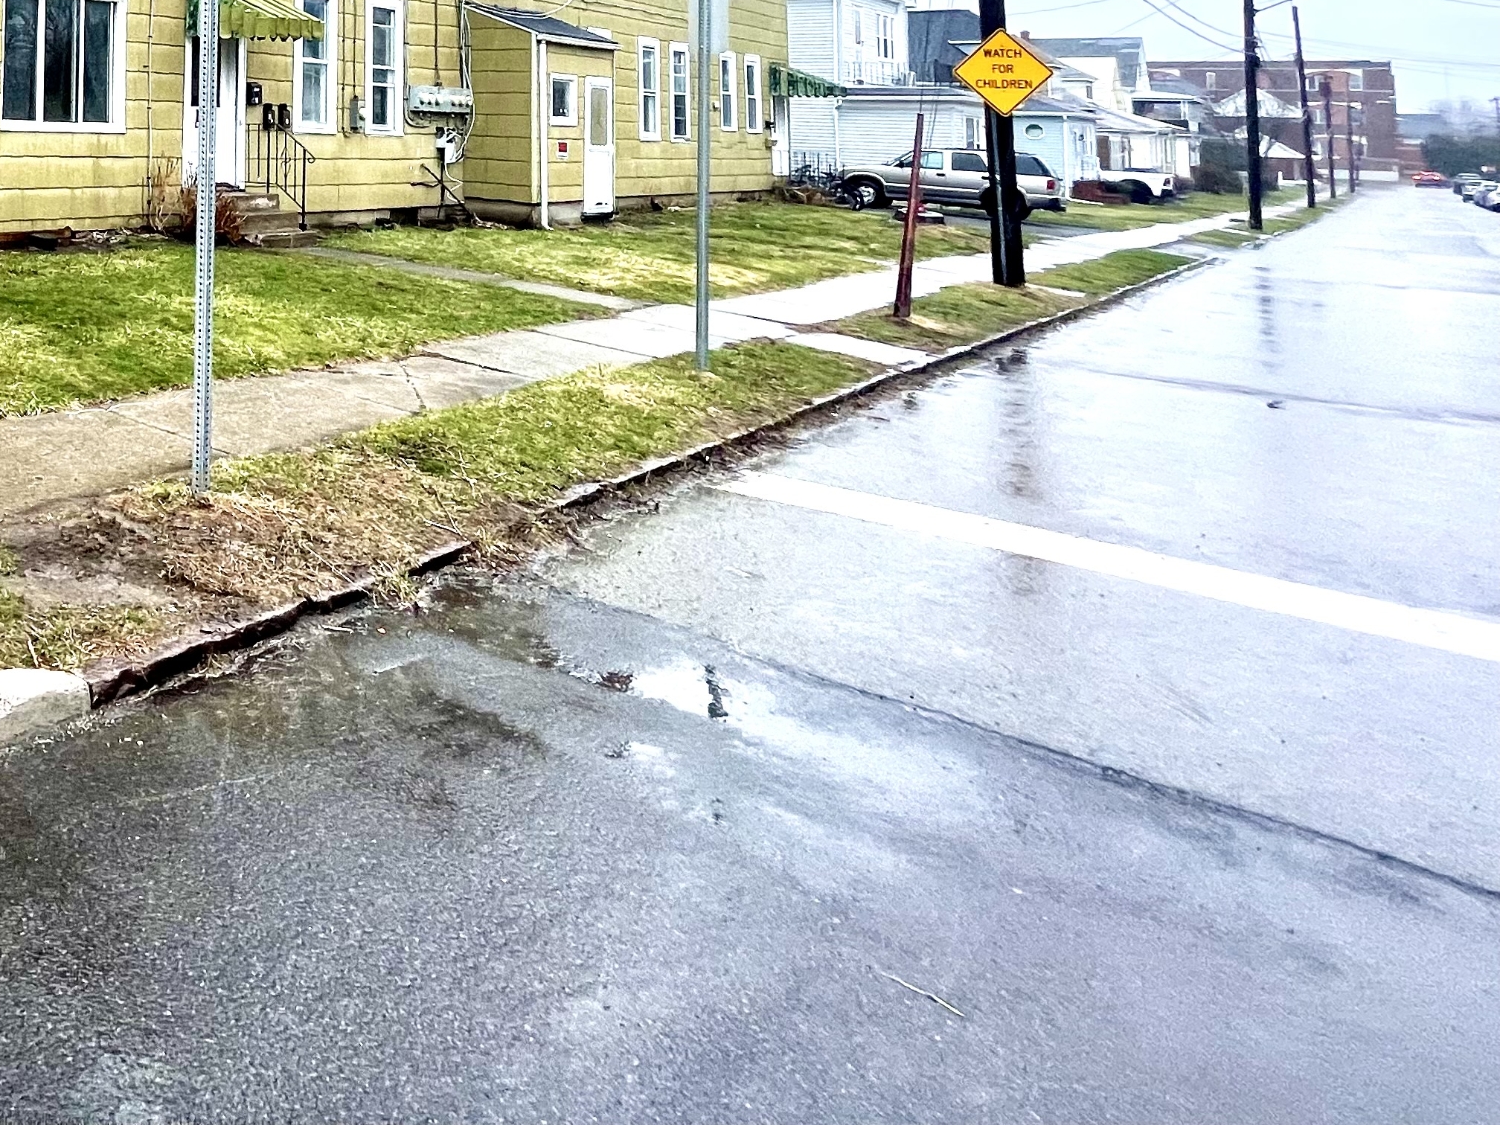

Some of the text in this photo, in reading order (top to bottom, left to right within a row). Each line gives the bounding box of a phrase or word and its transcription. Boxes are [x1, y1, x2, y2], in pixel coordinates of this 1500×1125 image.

[983, 49, 1022, 58] WATCH
[992, 64, 1014, 73] FOR
[975, 79, 1033, 89] CHILDREN
